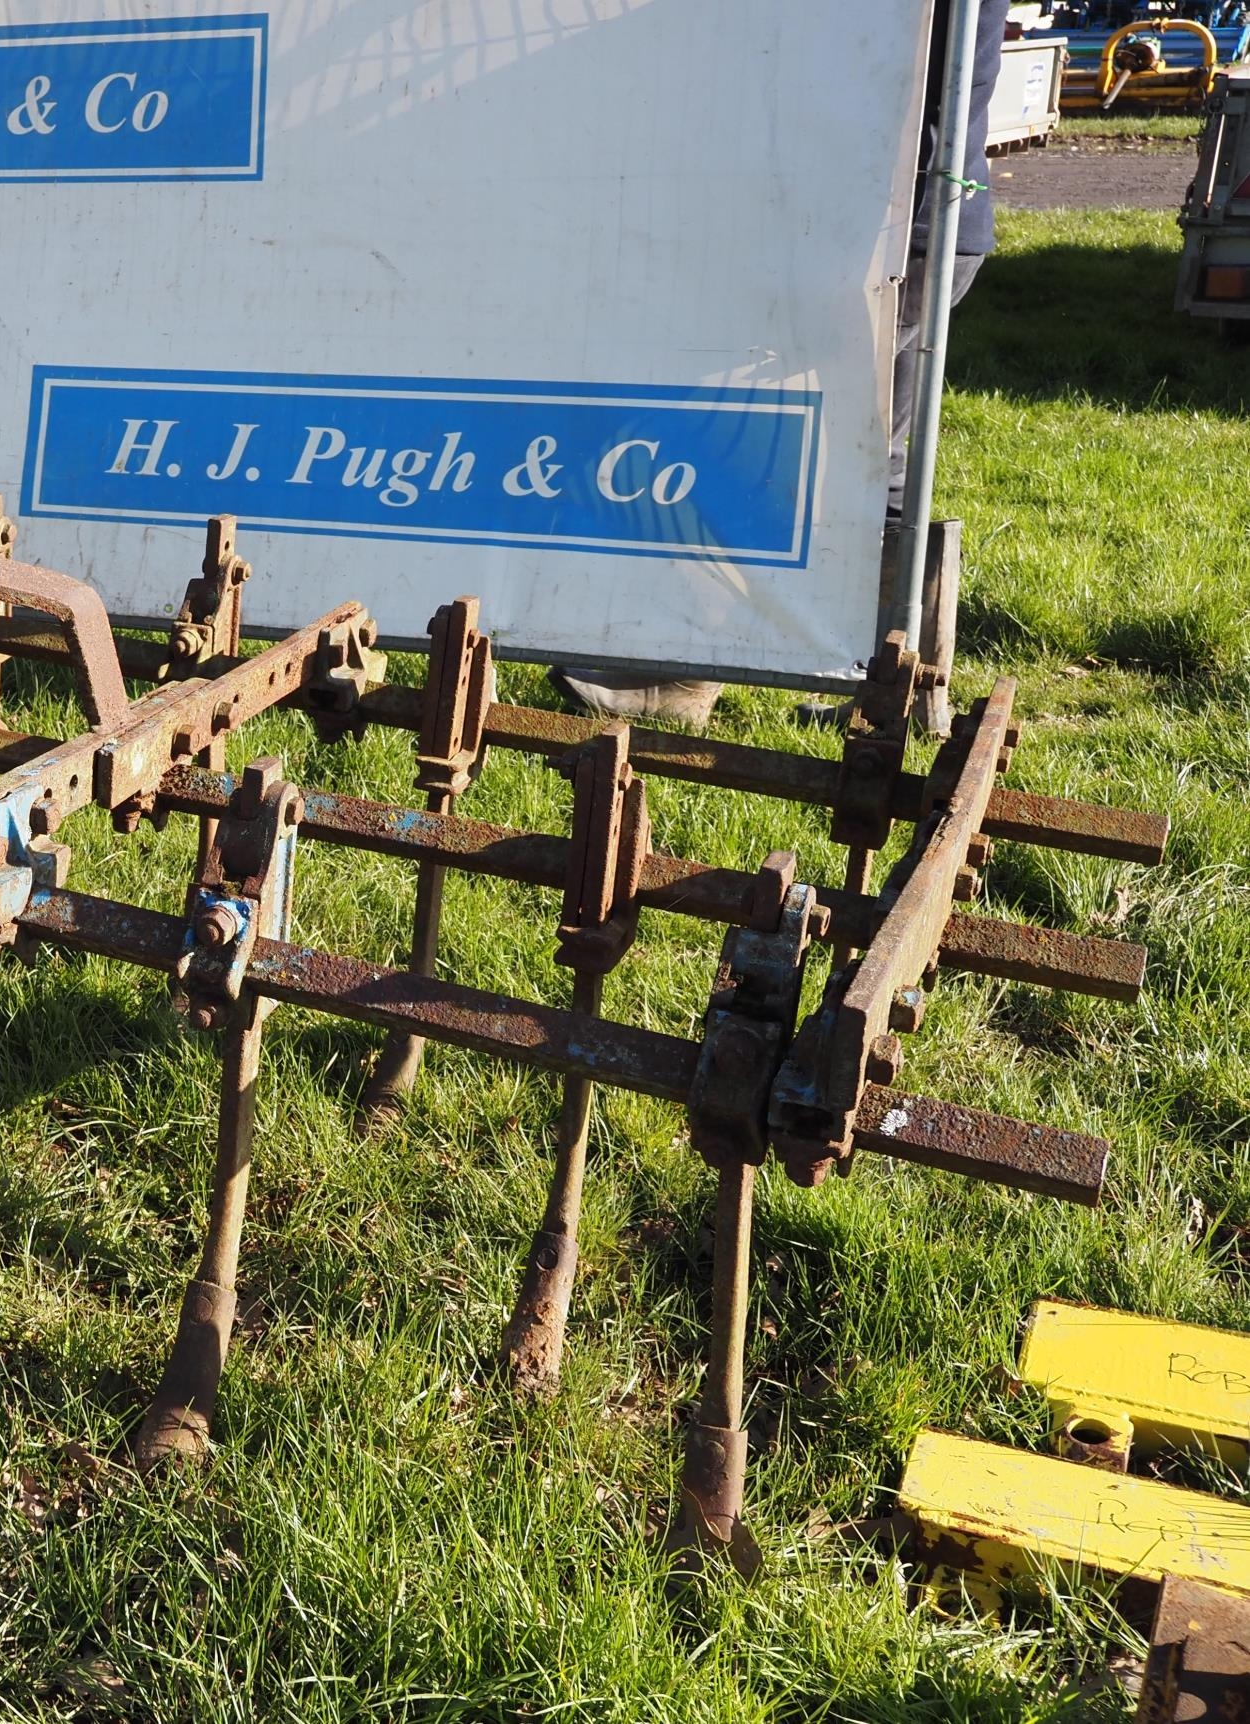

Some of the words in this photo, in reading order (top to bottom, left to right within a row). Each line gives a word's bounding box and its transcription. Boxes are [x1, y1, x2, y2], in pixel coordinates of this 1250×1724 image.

[7, 75, 57, 135] &
[85, 72, 169, 133] Co
[105, 418, 181, 478] H.
[206, 423, 260, 482] J.
[286, 426, 474, 507] Pugh
[502, 435, 563, 498] &
[596, 439, 697, 505] Co
